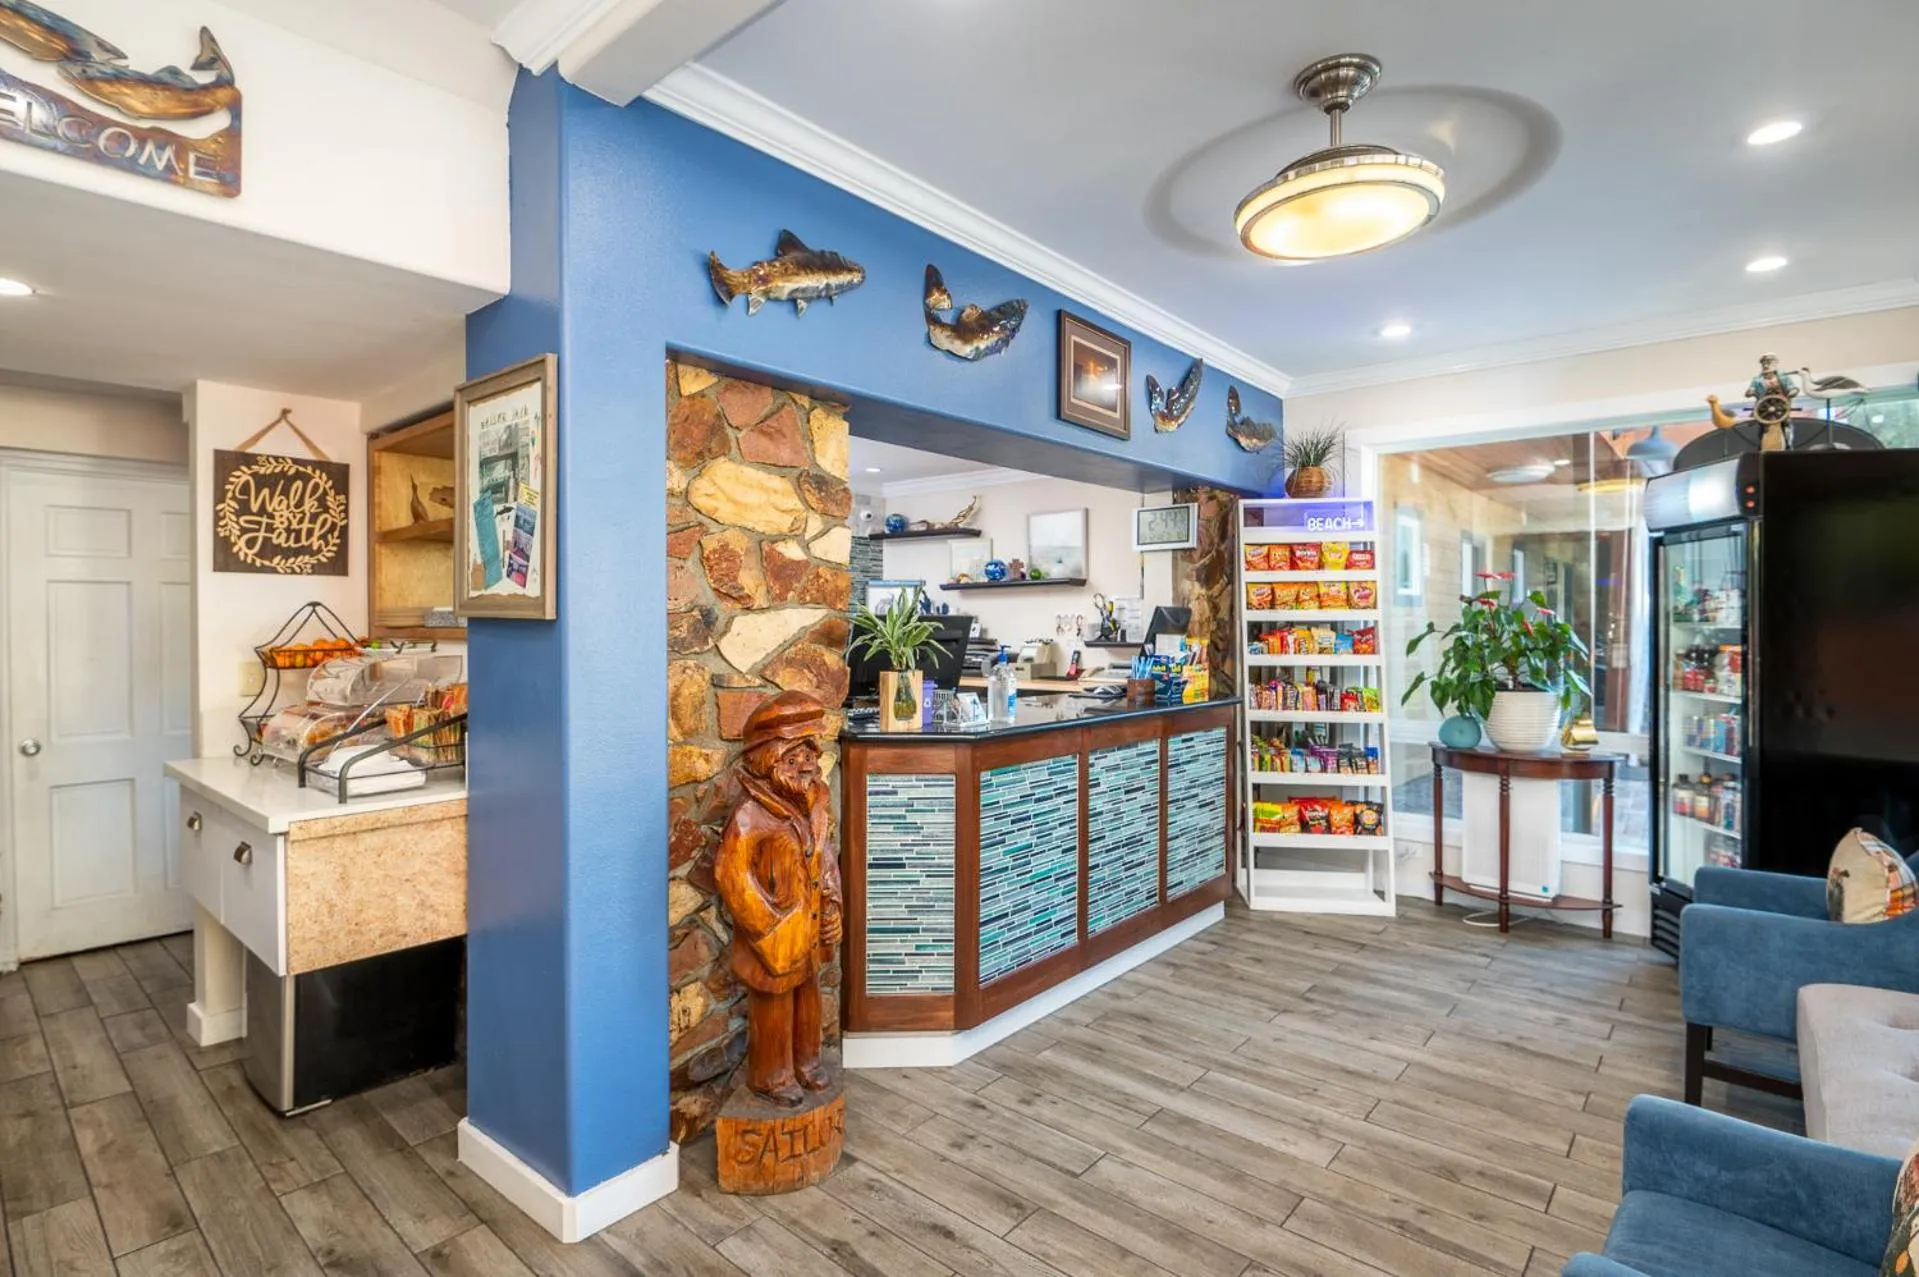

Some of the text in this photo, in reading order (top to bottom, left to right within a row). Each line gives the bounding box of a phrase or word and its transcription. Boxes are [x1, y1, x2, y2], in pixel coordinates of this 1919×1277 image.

[235, 475, 324, 514] Walk
[239, 513, 333, 555] Faith
[1307, 516, 1352, 532] BEACH
